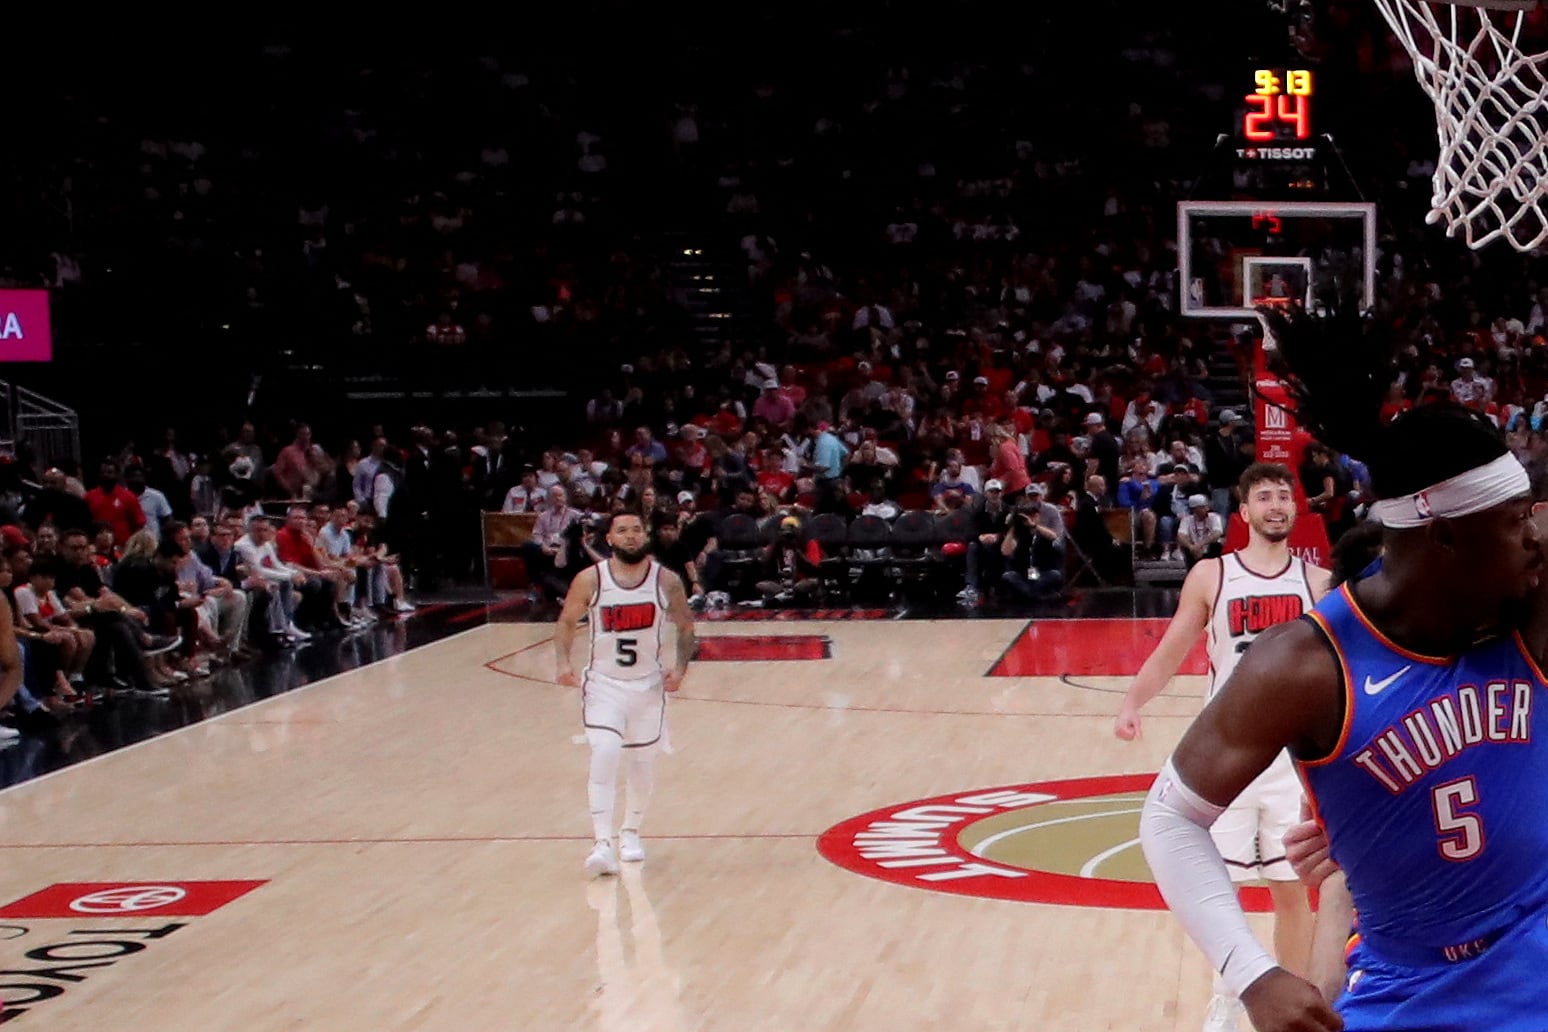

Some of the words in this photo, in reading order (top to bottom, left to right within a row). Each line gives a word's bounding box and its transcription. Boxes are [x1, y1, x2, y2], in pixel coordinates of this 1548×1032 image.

[1244, 95, 1309, 139] 24
[616, 639, 637, 667] 5
[1355, 681, 1531, 794] THUNDER
[1431, 778, 1483, 860] 5
